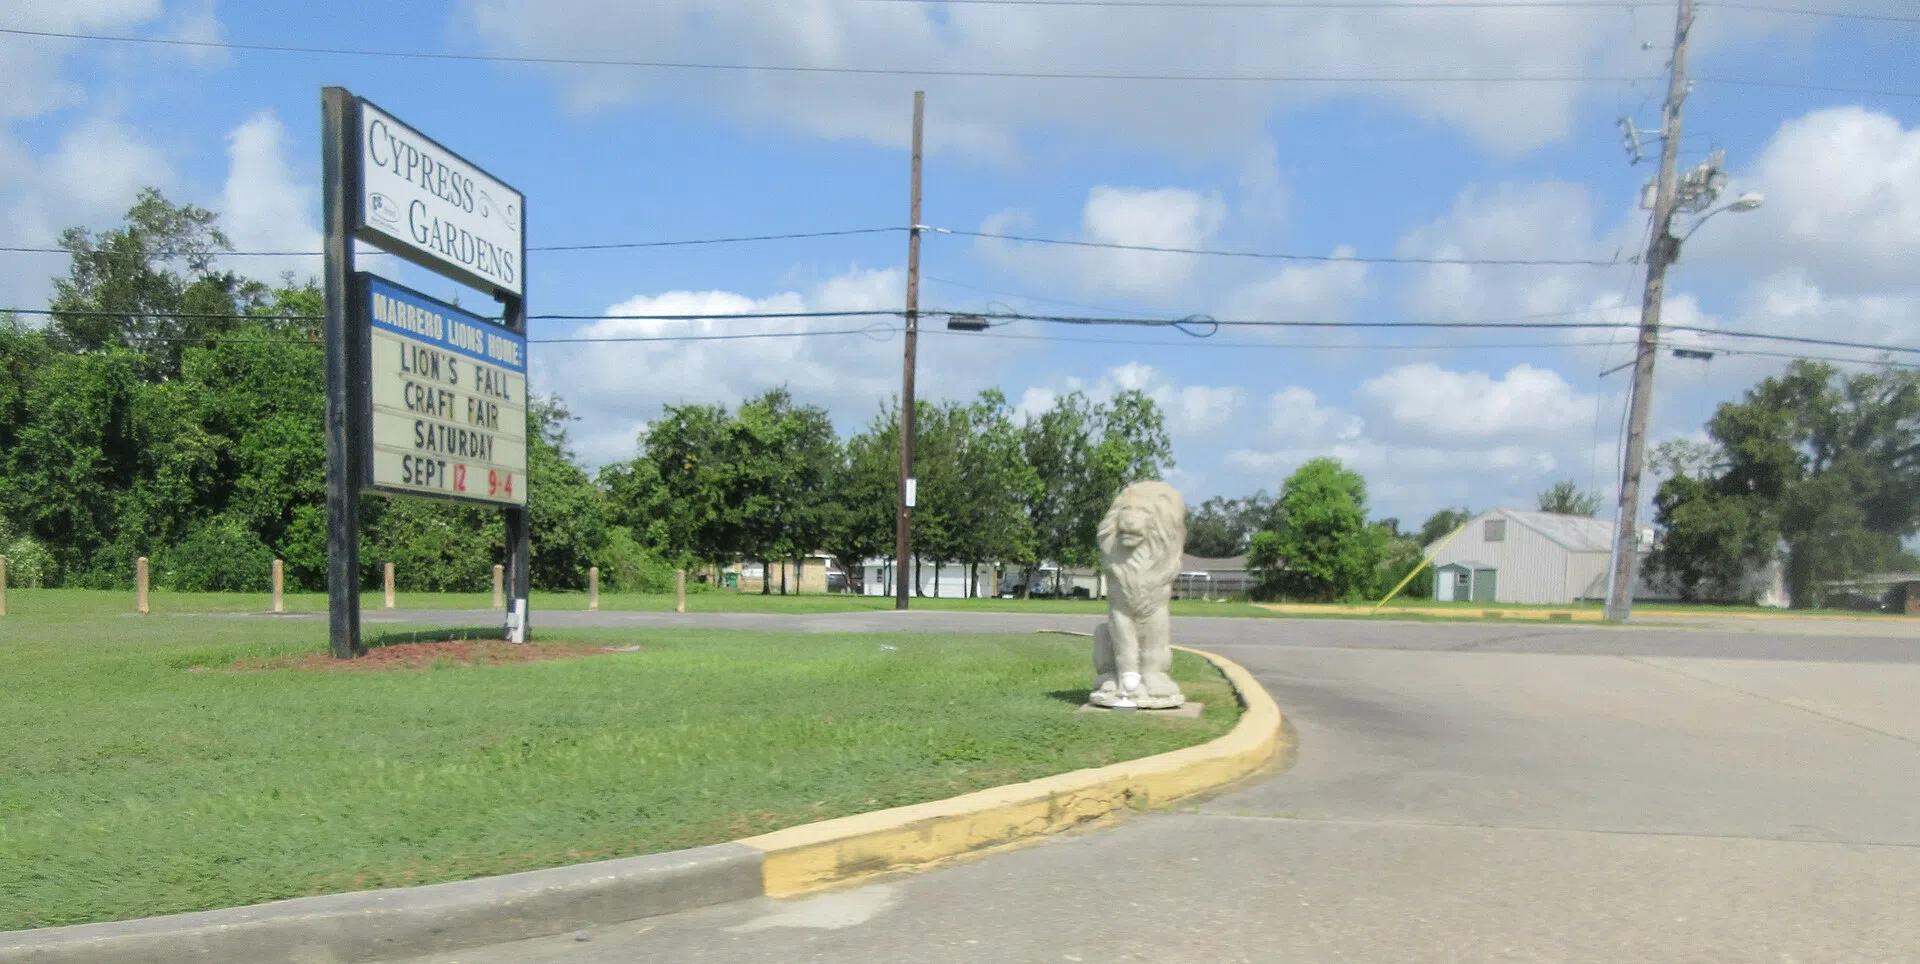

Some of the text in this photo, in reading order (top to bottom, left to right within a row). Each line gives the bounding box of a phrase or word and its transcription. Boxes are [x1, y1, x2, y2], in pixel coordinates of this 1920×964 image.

[369, 119, 474, 214] CYPRESS
[409, 199, 514, 284] GARDENS
[373, 293, 443, 341] MARRERO
[448, 318, 484, 353] LIONS
[401, 342, 510, 400] LION'S FALL
[405, 381, 498, 429] CRAFT FAIR
[415, 420, 494, 461] SATURDAY
[402, 454, 513, 496] SEPT 12 9-4
